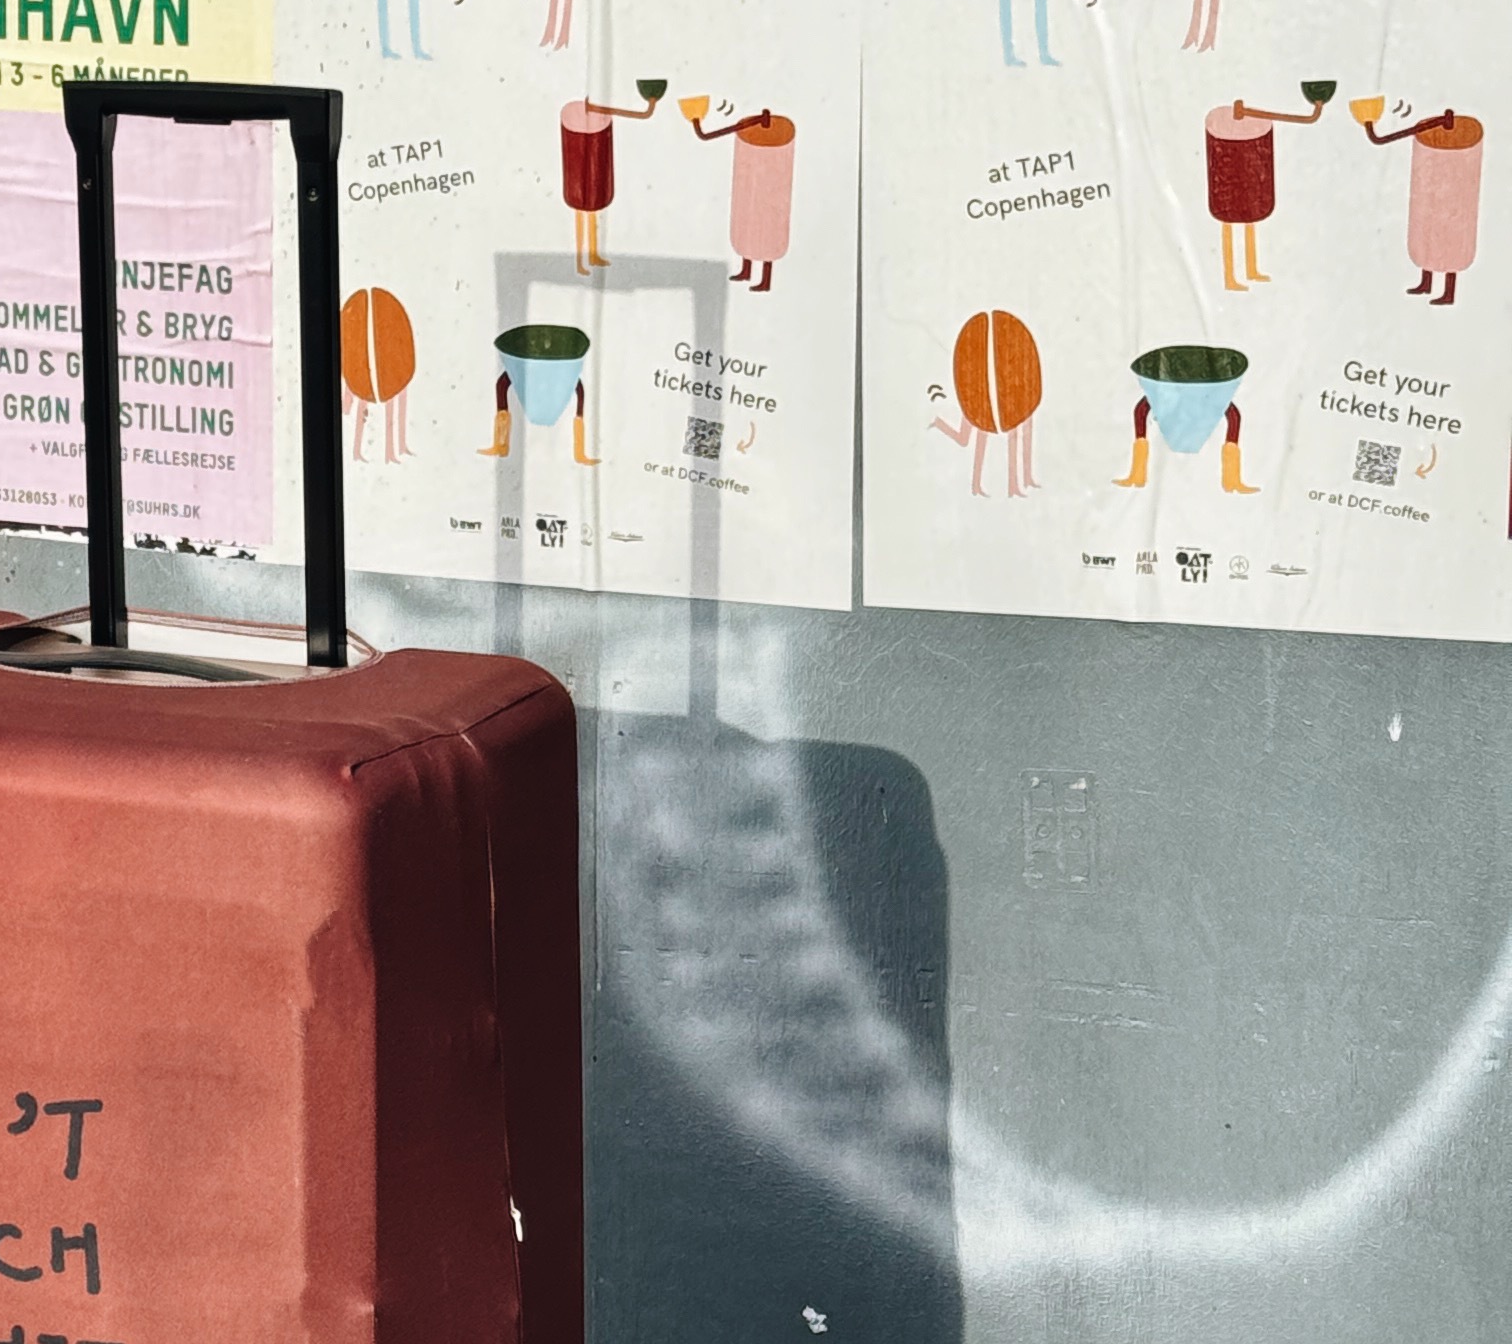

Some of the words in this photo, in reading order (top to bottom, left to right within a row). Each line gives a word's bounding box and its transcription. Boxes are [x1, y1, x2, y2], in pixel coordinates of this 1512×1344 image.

[368, 150, 387, 168] at
[391, 140, 442, 164] TAP1
[989, 163, 1011, 183] at
[1015, 151, 1074, 178] TAP1
[348, 171, 474, 203] Copenhagen
[967, 183, 1110, 220] Copenhagen
[675, 342, 713, 367] Get
[719, 355, 767, 377] your
[654, 369, 723, 401] tickets
[730, 385, 776, 413] here
[1344, 361, 1387, 387] Get
[1395, 375, 1451, 397] your
[1321, 390, 1399, 422] tickets
[1407, 405, 1461, 434] here
[1309, 490, 1325, 501] or
[1328, 494, 1343, 506] at
[1347, 494, 1430, 522] DCF.coffee
